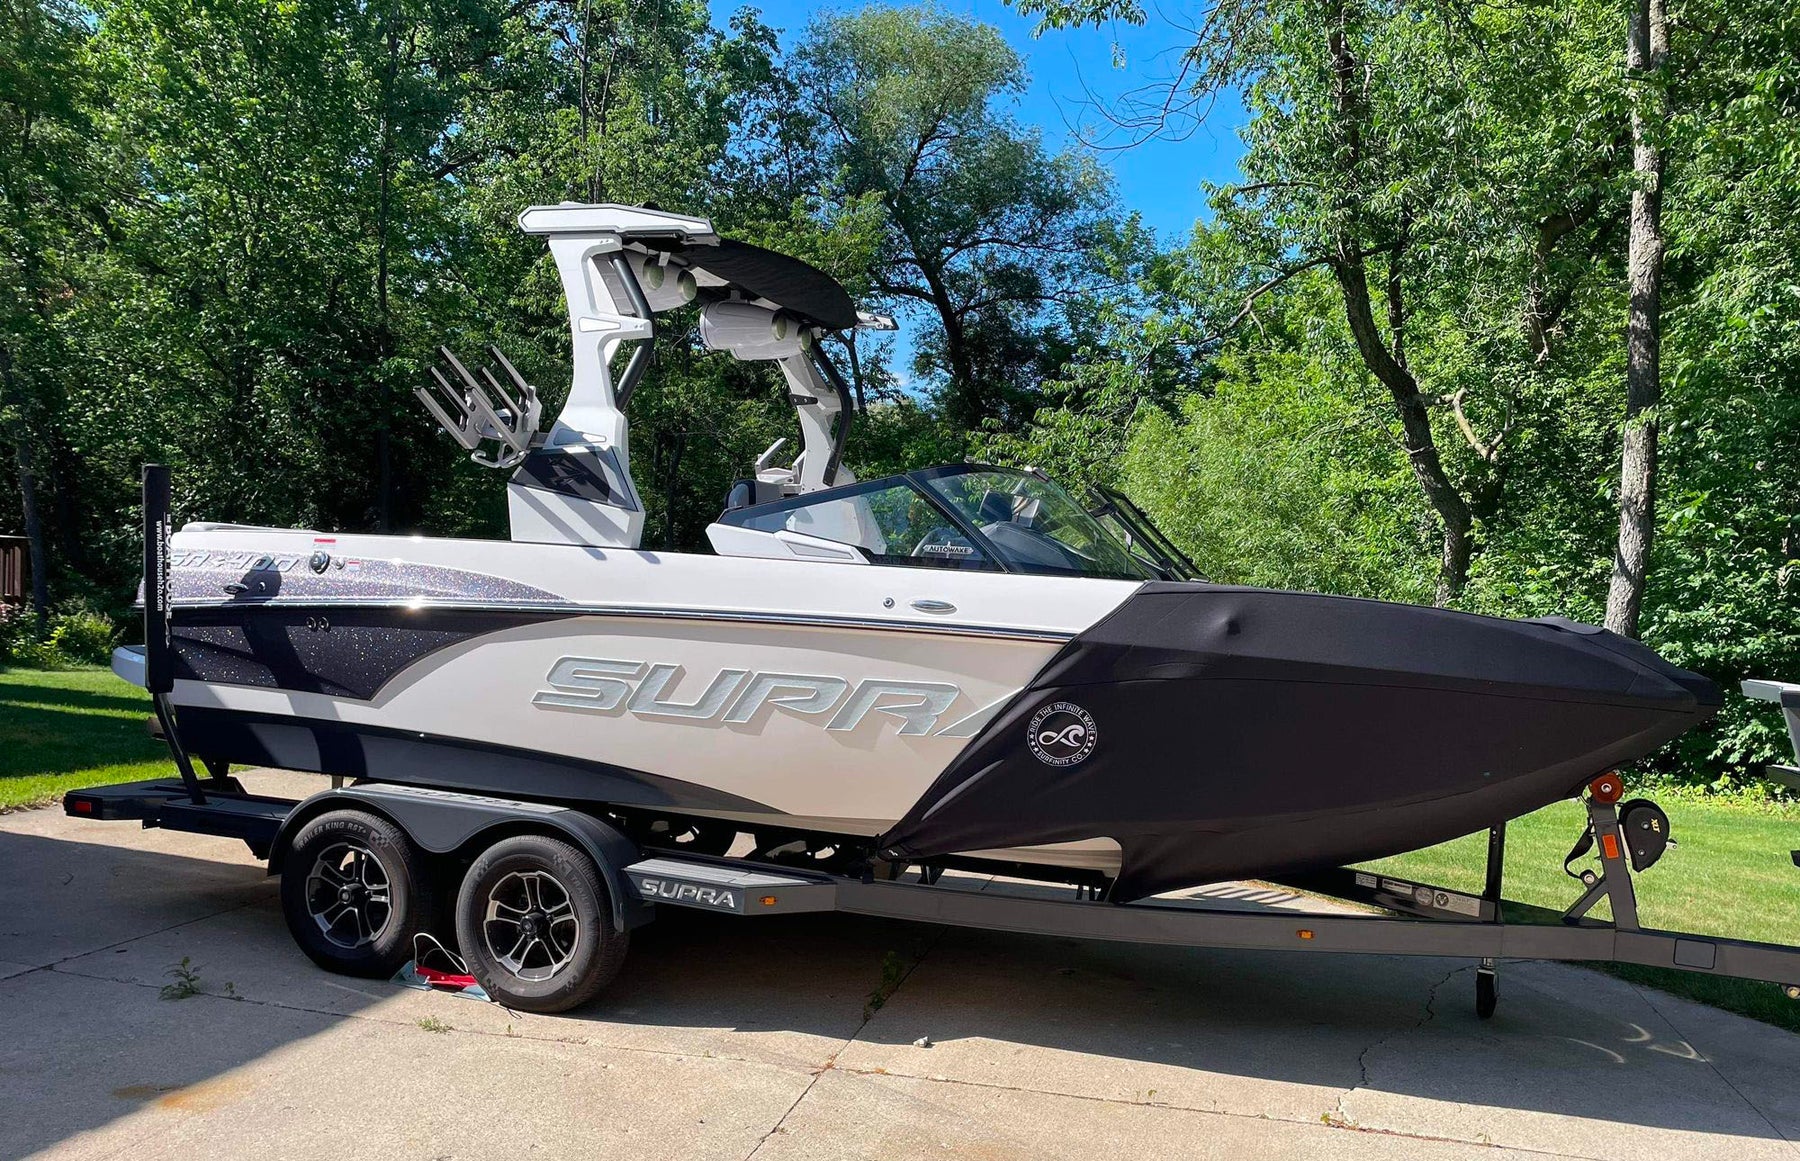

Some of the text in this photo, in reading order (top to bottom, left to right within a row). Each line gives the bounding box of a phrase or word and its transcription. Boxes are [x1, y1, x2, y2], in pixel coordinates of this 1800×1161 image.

[929, 545, 969, 554] AUTOWAKE
[156, 520, 165, 611] www.boathouseh2o.com
[1030, 704, 1096, 735] RIDE THE INFINITE WAVE
[1037, 750, 1069, 765] SURFINITY
[325, 821, 345, 831] KING
[1650, 818, 1661, 833] XLT
[640, 879, 735, 908] SUPRA
